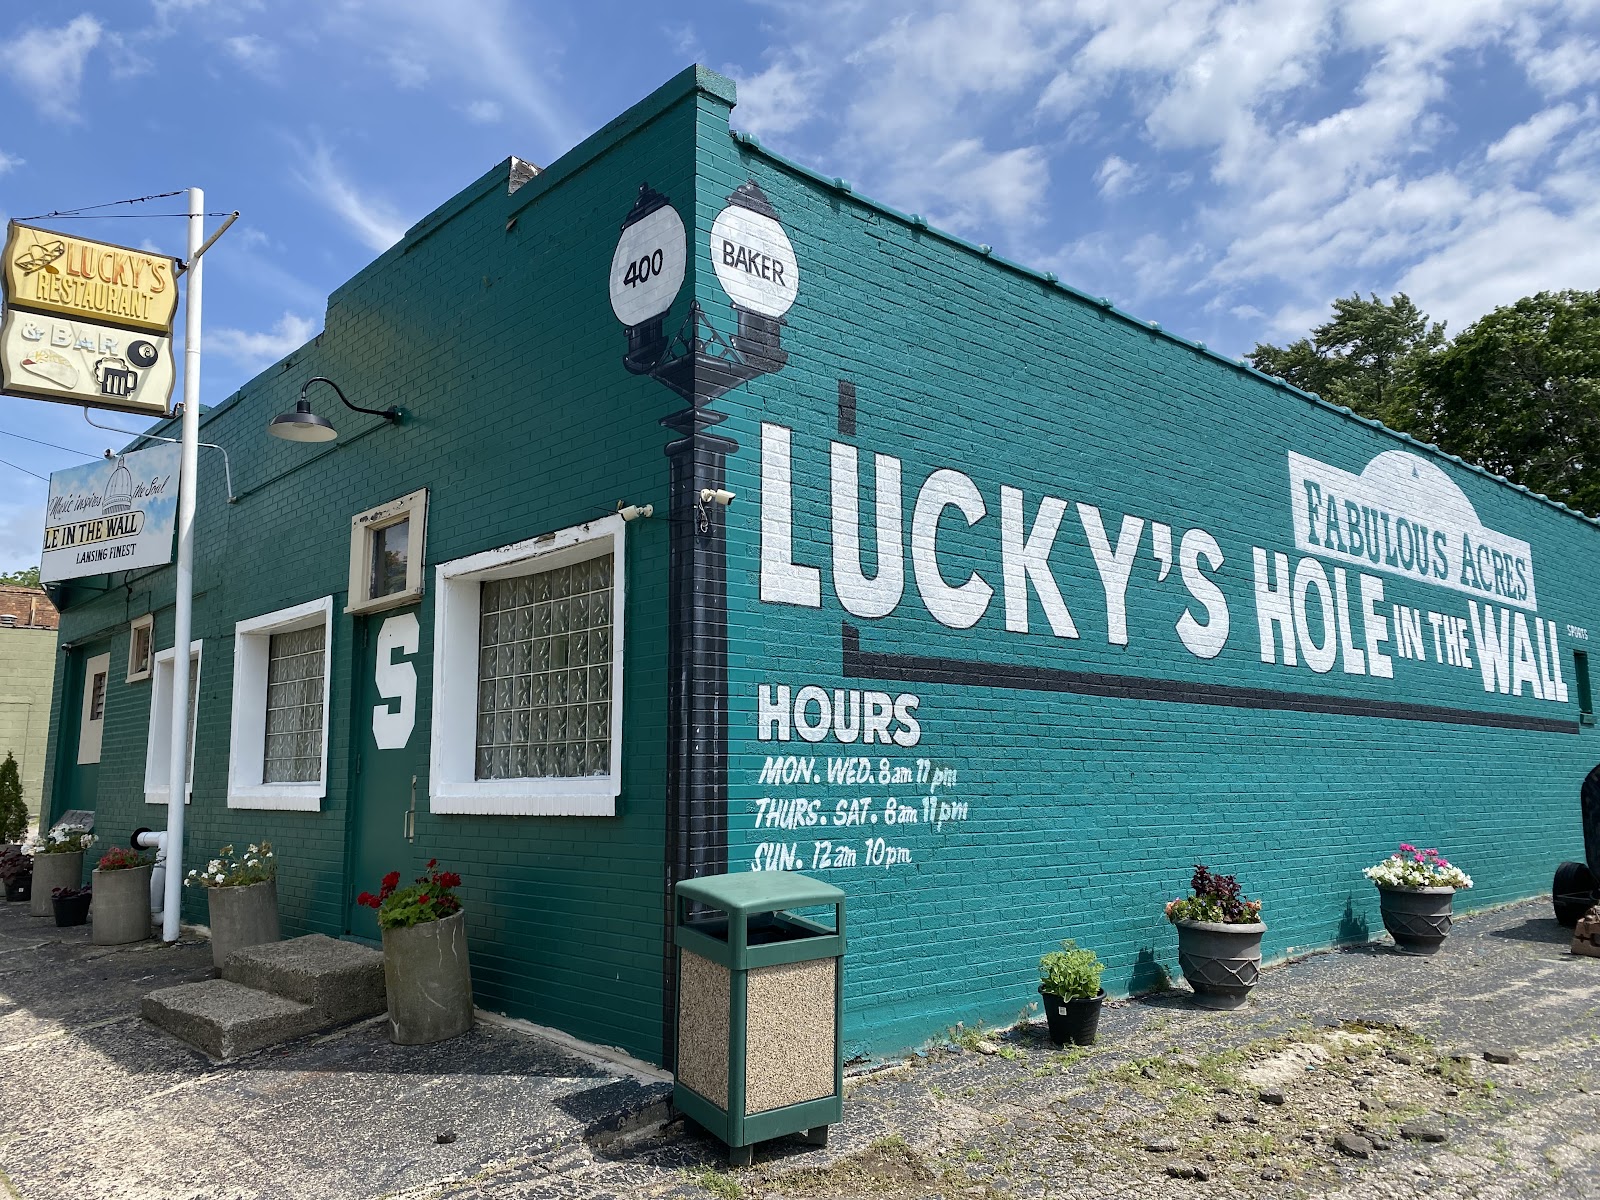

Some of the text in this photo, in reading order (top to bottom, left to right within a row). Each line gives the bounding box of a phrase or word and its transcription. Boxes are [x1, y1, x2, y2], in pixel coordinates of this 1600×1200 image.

[67, 242, 166, 292] LUCKY'S
[623, 248, 663, 288] 400
[722, 239, 786, 287] BAKER
[36, 272, 153, 319] RESTAURANT
[21, 321, 119, 356] & BAR
[49, 475, 170, 520] Music inspires the Soul
[61, 526, 76, 546] IN
[79, 521, 103, 542] THE
[106, 514, 138, 537] WALL
[759, 420, 1231, 659] LUCKY'S
[1303, 479, 1528, 601] FABULOUS ACRES
[76, 543, 136, 564] LANSING FINEST
[1252, 546, 1569, 702] HOLE IN THE WALL
[372, 612, 420, 750] S
[757, 683, 922, 748] HOURS
[758, 756, 820, 786] MON.
[827, 757, 875, 785] WED.
[878, 757, 913, 785] 8am
[755, 797, 827, 829] THURS.
[833, 797, 878, 827] SAT.
[884, 797, 918, 825] 8am
[751, 837, 912, 872] SUN. 12am 10pm
